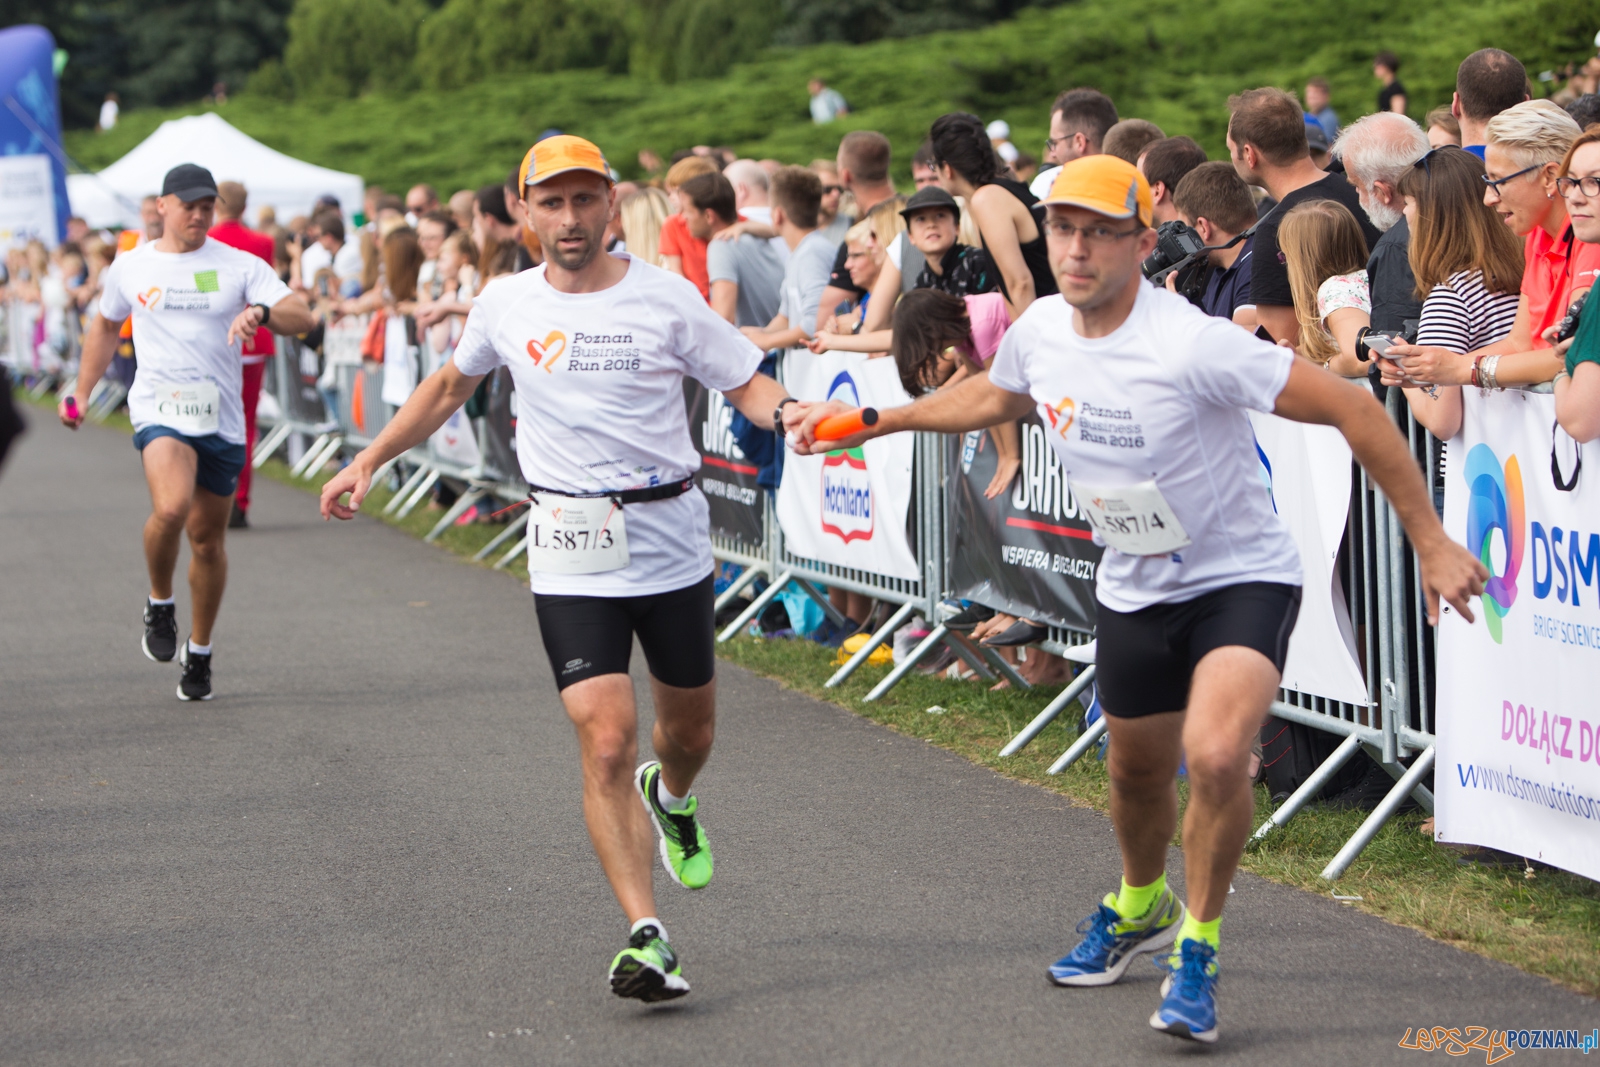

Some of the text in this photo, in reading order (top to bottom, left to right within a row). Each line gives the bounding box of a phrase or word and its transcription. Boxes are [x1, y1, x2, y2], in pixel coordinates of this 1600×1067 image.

[573, 332, 633, 344] Poznań
[570, 345, 640, 358] Business
[567, 358, 641, 371] Run 2016
[1081, 402, 1132, 420] Poznań
[1079, 416, 1143, 434] Business
[1080, 429, 1145, 448] Run 2016
[823, 474, 870, 518] Hochland
[1002, 545, 1050, 571] WSPIERA
[1531, 521, 1600, 610] DSM
[1501, 700, 1573, 765] DOŁĄCZ
[1457, 763, 1600, 822] www.dsmnutrition
